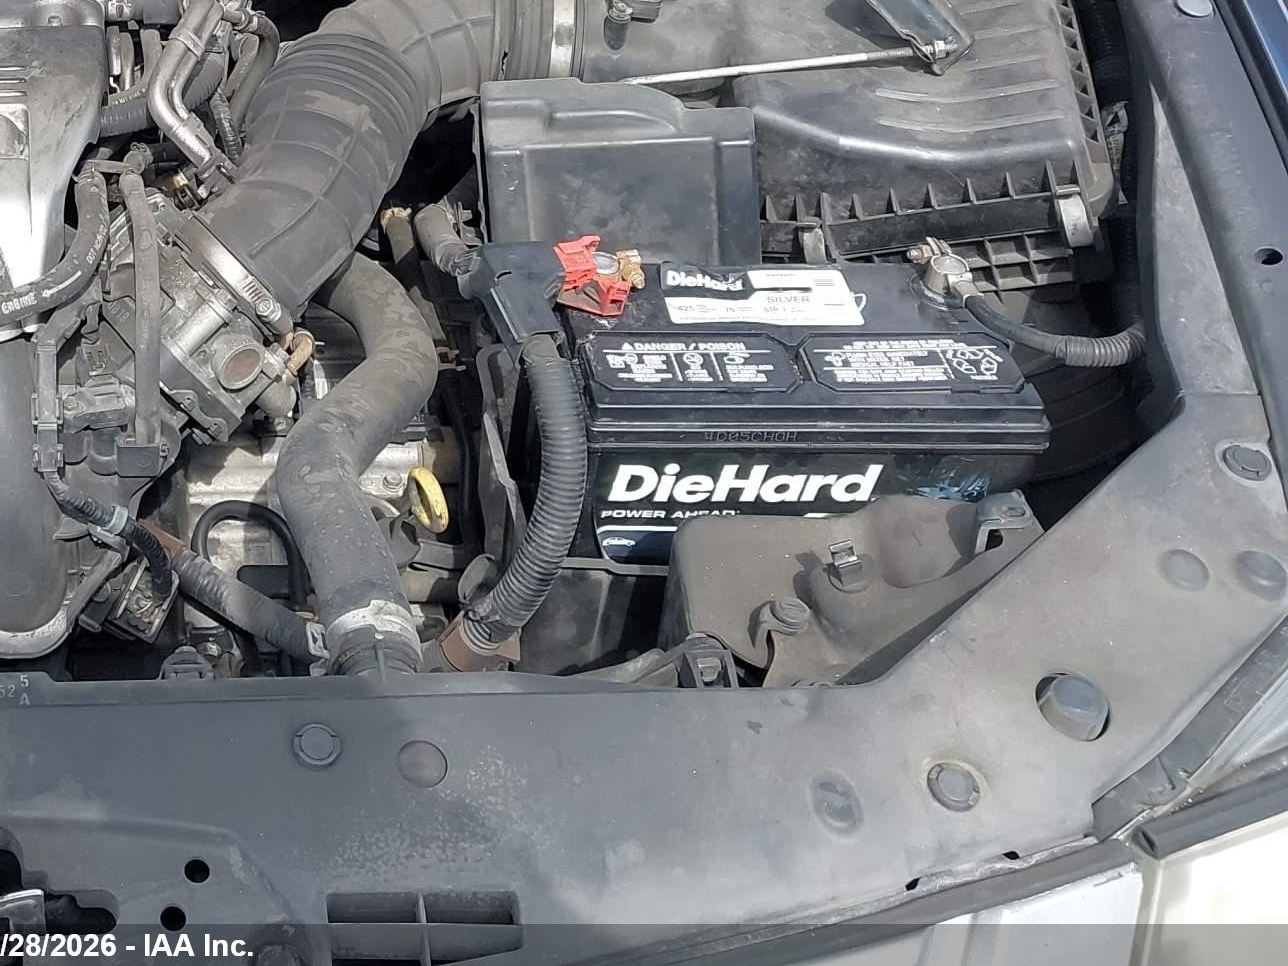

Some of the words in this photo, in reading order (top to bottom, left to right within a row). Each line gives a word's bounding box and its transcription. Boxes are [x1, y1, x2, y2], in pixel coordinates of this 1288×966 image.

[666, 270, 745, 291] DieHard
[767, 296, 810, 304] SILVER
[634, 343, 687, 351] DANGER
[698, 343, 746, 351] POISON
[607, 463, 884, 503] DieHard
[600, 510, 666, 518] POWER
[20, 674, 29, 687] 5
[19, 693, 31, 706] A
